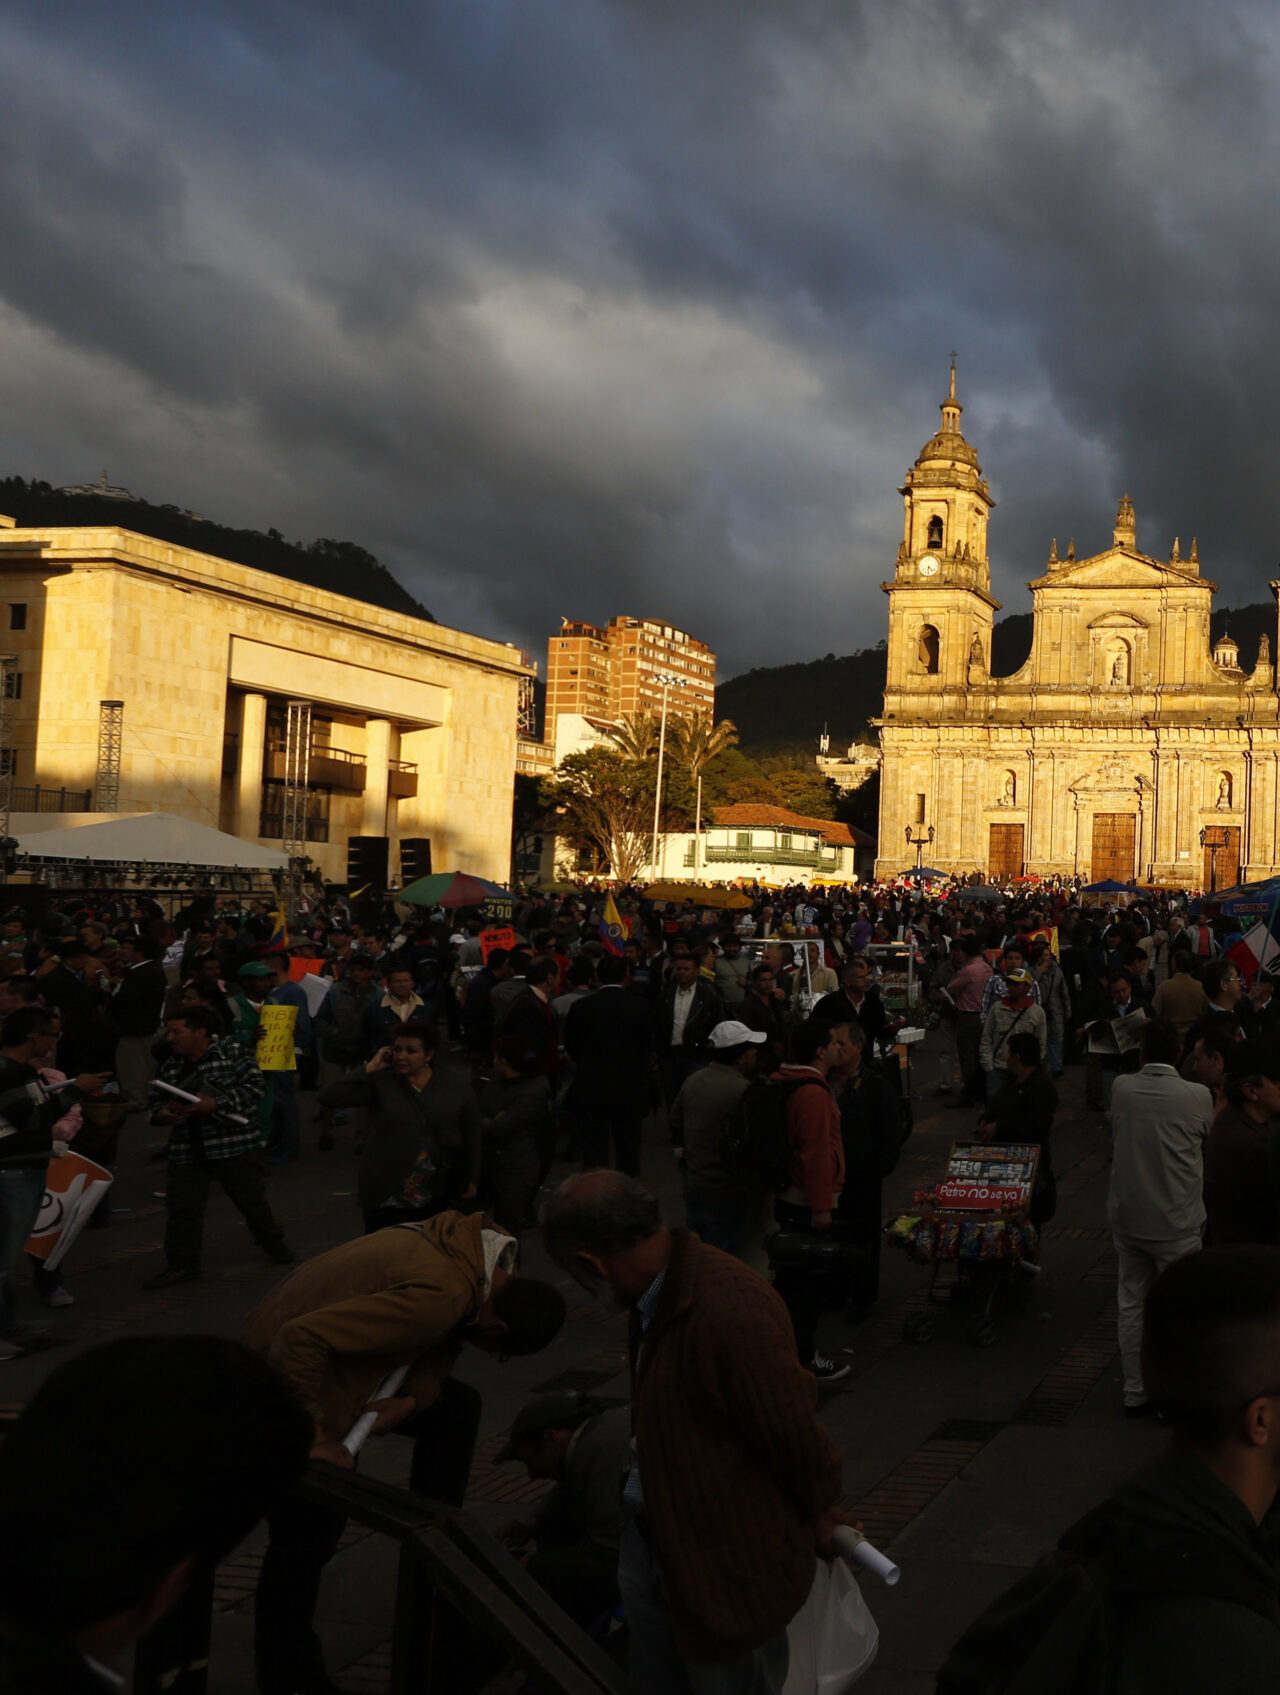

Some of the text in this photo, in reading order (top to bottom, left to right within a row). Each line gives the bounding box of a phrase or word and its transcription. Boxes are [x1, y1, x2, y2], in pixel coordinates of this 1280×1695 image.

[487, 904, 512, 919] 200
[940, 1185, 967, 1198] Petro
[1004, 1190, 1018, 1200] va
